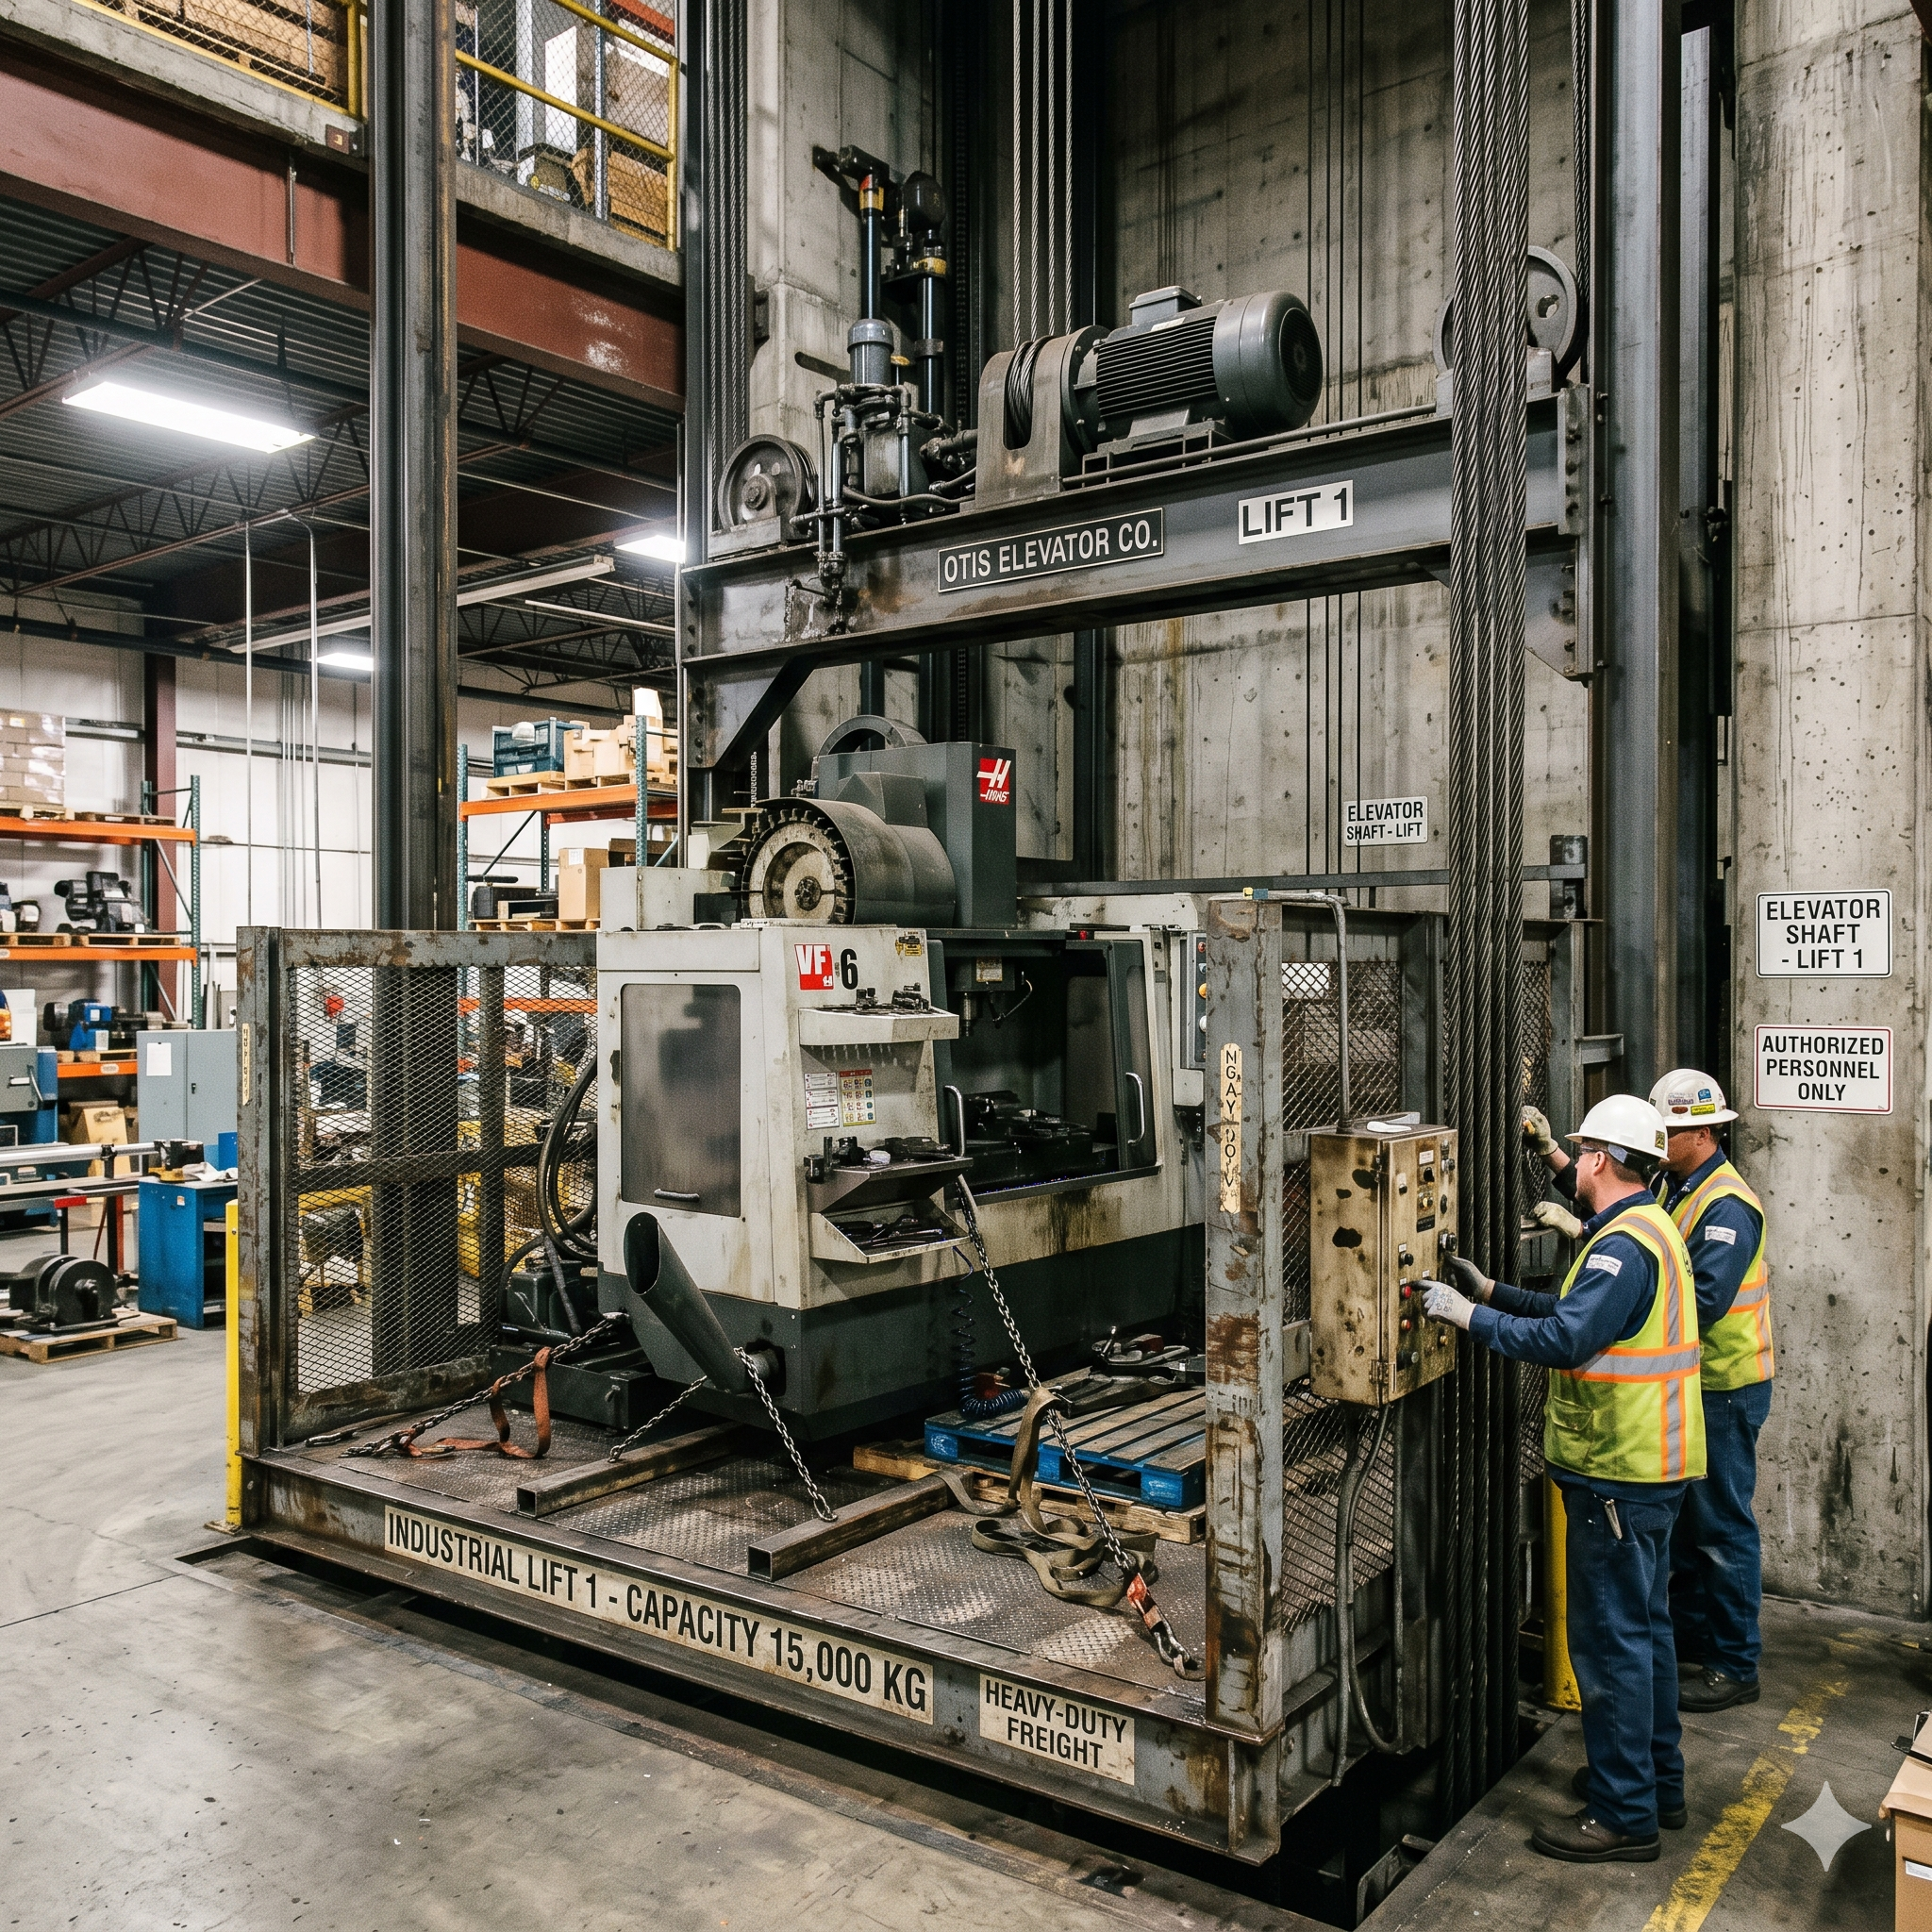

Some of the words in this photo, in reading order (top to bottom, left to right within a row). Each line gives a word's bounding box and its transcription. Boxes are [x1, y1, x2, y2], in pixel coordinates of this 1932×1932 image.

[1242, 491, 1321, 538] LIFT
[1333, 487, 1347, 521] 1
[944, 549, 991, 583] OTIS
[999, 527, 1109, 574] ELEVATOR
[1118, 520, 1158, 553] CO.
[1347, 801, 1424, 822] ELEVATOR
[1346, 824, 1386, 840] SHAFT
[1396, 822, 1423, 838] LIFT
[1766, 898, 1881, 921] ELEVATOR
[1786, 924, 1860, 944] SHAFT
[795, 944, 826, 975] VF
[840, 948, 858, 991] 6
[1797, 949, 1845, 969] LIFT
[1853, 948, 1862, 969] 1
[1762, 1035, 1884, 1056] AUTHORIZED
[1766, 1058, 1880, 1079] PERSONNEL
[1225, 1050, 1238, 1114] NGAY
[1798, 1082, 1846, 1101] ONLY
[389, 1512, 520, 1585] INDUSTRIAL
[527, 1554, 578, 1602] LIFT
[585, 1573, 596, 1608] 1
[608, 1595, 618, 1604] -
[626, 1584, 760, 1657] CAPACITY
[770, 1627, 872, 1694] 15,000
[883, 1659, 926, 1712] KG
[986, 1679, 1127, 1743] HEAVY-DUTY
[1008, 1716, 1104, 1769] FREIGHT
